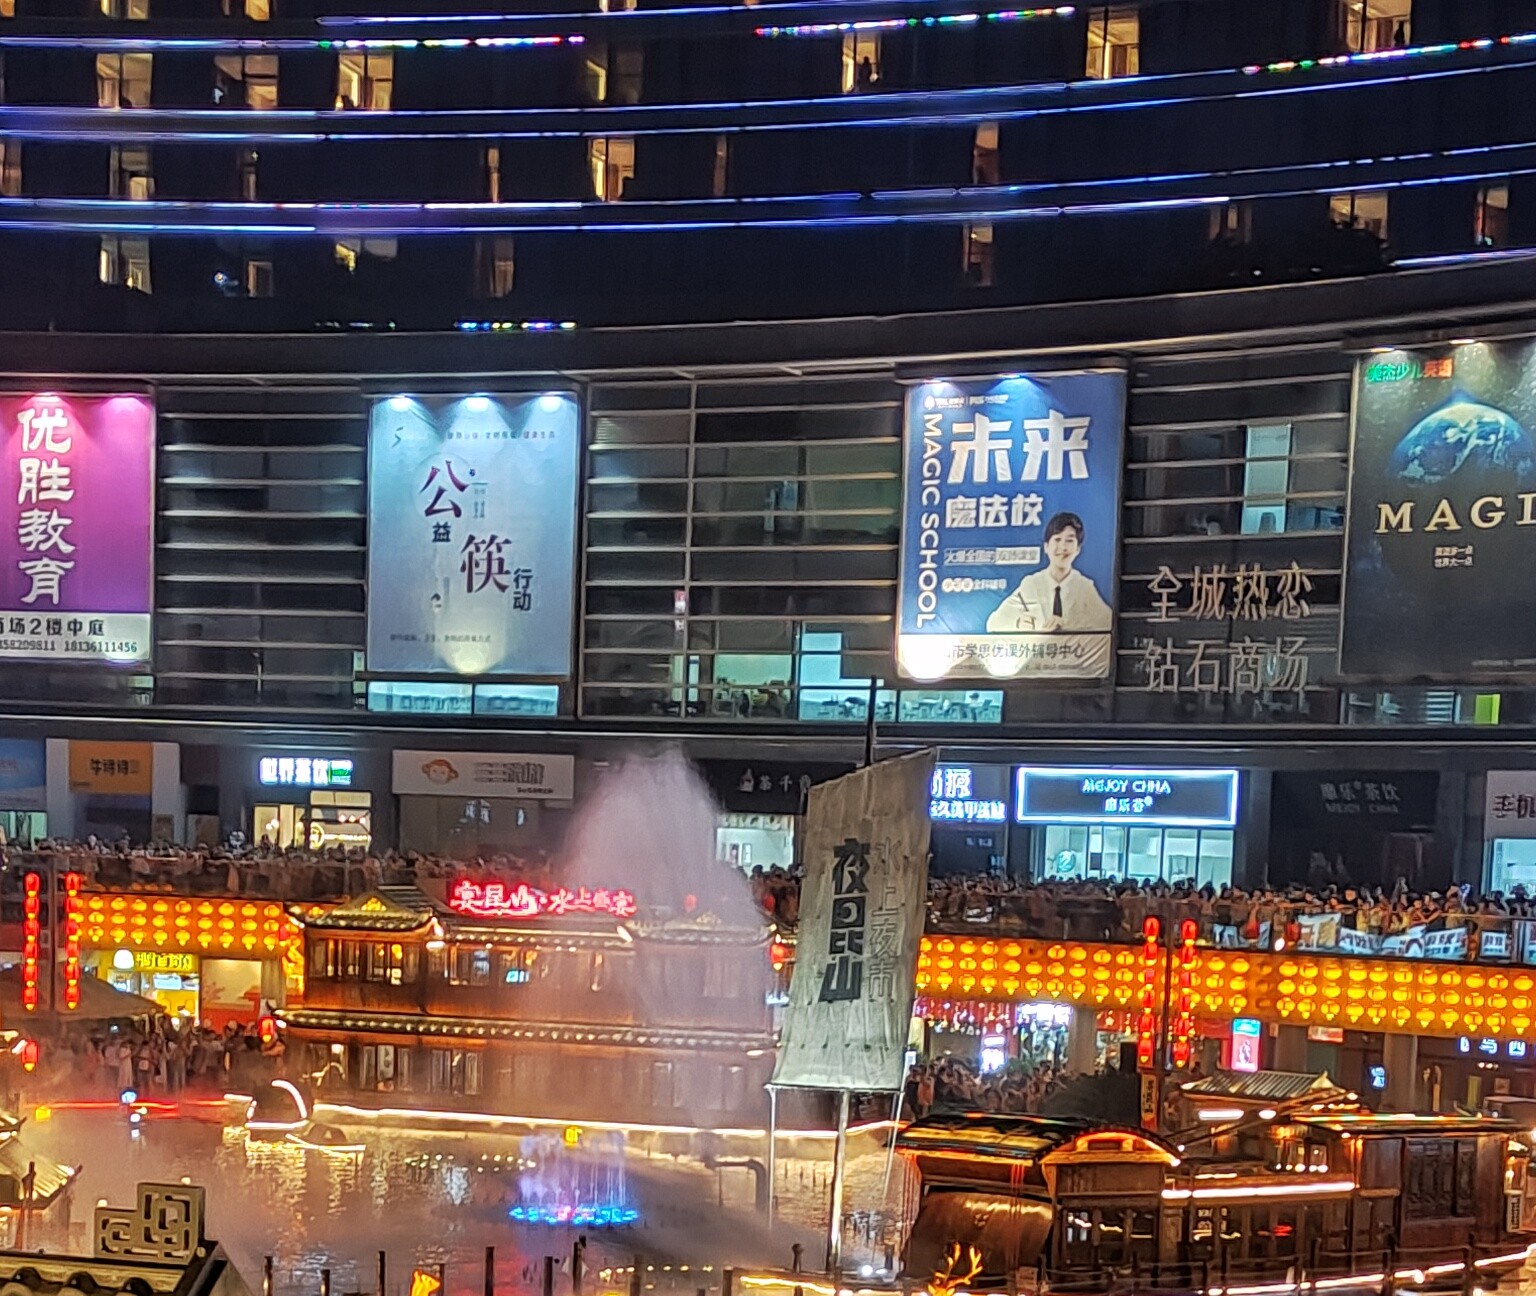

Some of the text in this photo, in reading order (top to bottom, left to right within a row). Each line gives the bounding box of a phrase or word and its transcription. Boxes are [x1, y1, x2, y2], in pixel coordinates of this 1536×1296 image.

[947, 409, 1091, 484] 未来
[17, 408, 76, 605] 优胜教育
[916, 413, 943, 628] MAGIC SCHOOL
[945, 493, 1044, 529] 魔法校
[513, 568, 533, 612] 行动
[1146, 560, 1313, 623] 全城热恋
[947, 642, 1085, 660] 市学思优课外辅导中心
[1144, 635, 1309, 693] 钻石商场
[866, 836, 905, 1000] 水上夜市
